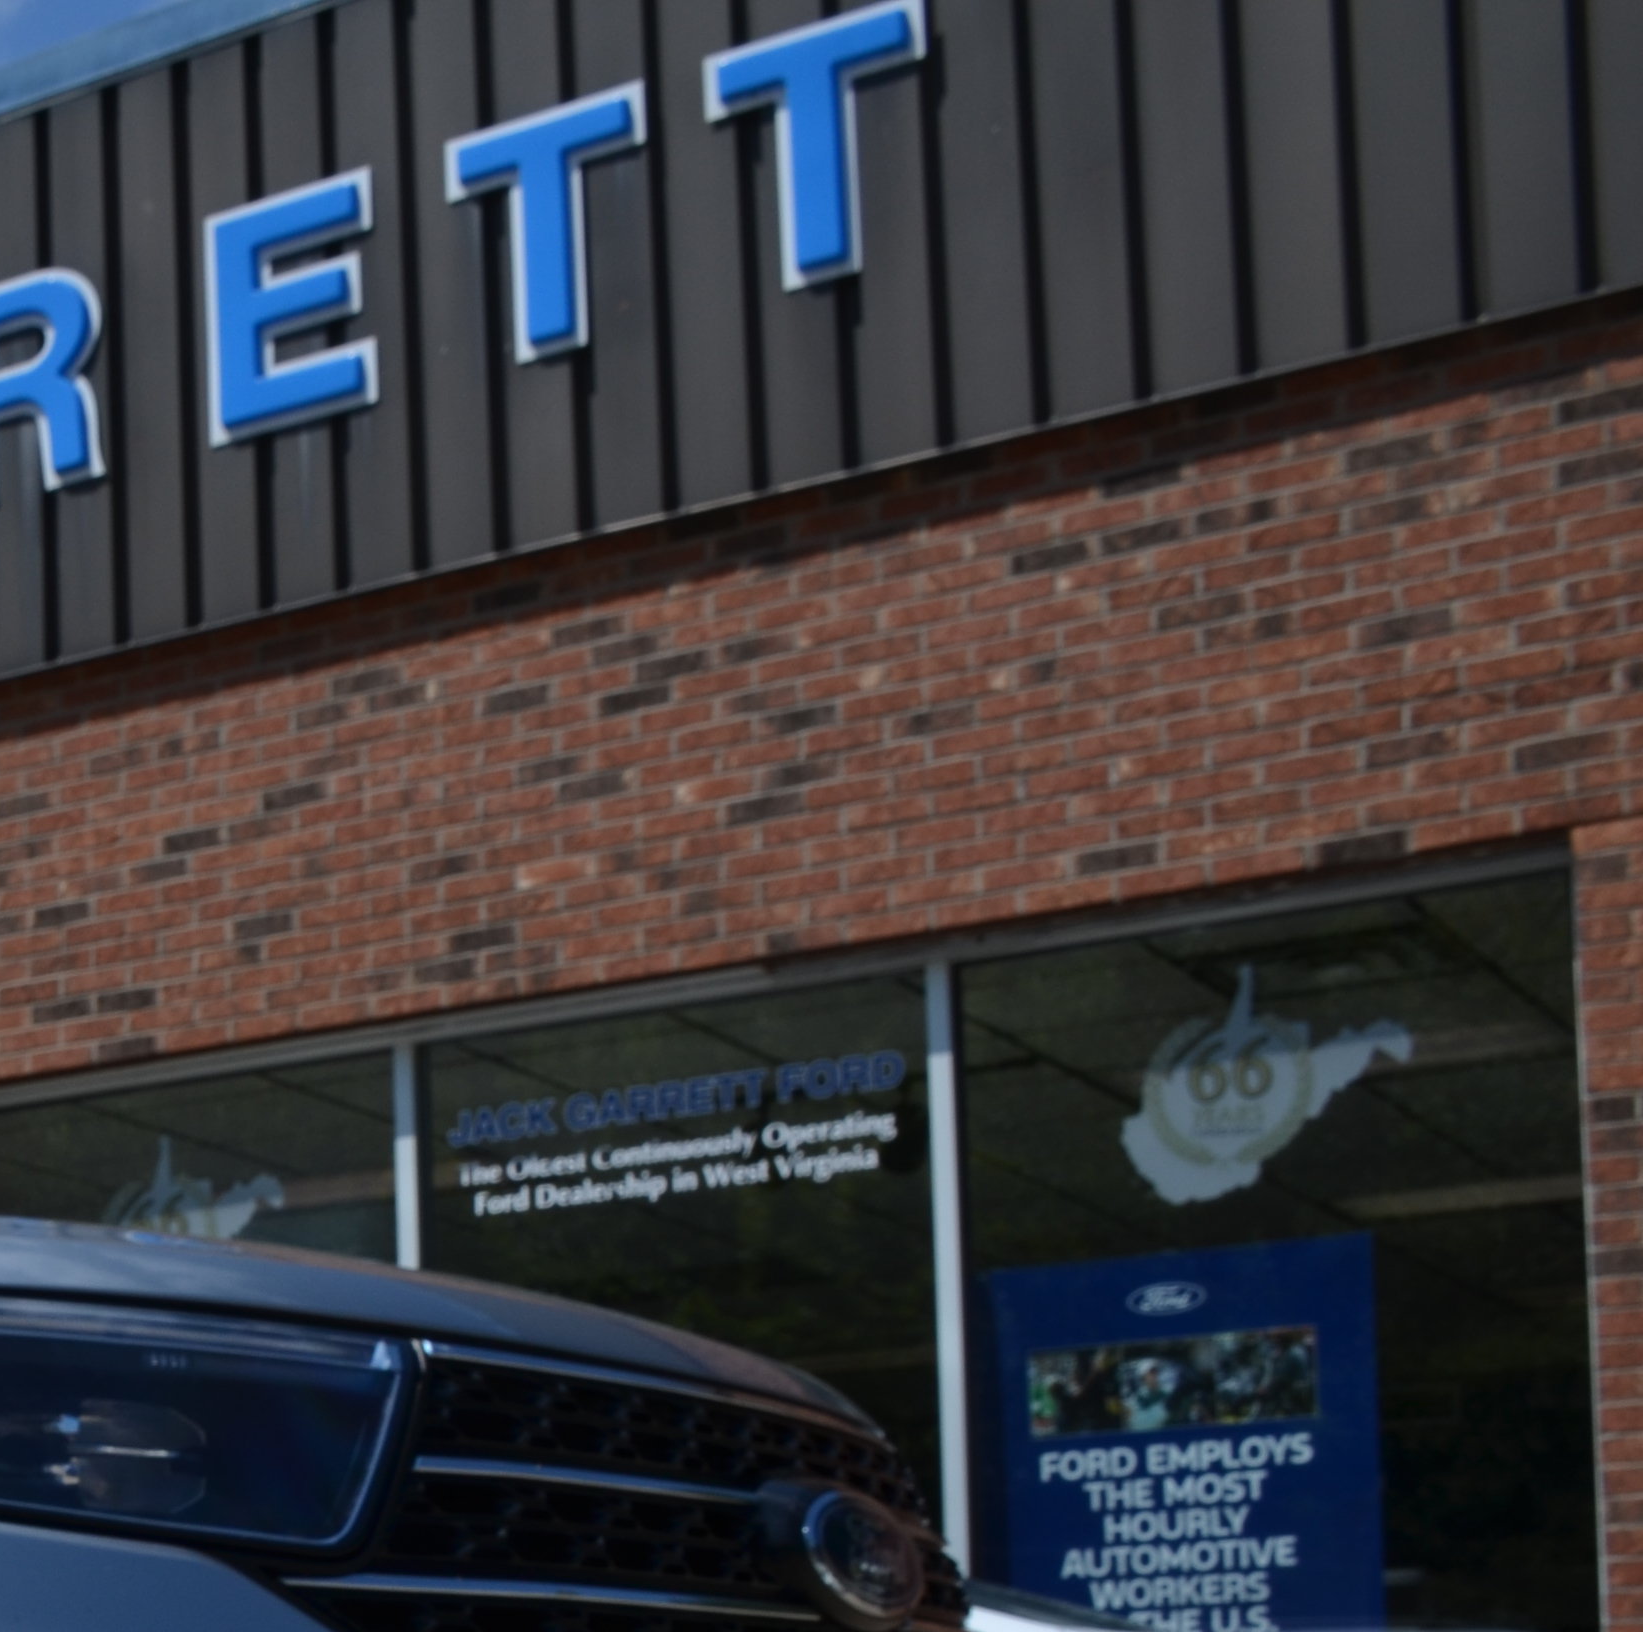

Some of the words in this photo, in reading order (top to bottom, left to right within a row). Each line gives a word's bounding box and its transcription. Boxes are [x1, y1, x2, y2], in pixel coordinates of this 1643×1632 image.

[1188, 1036, 1273, 1104] 66
[447, 1099, 558, 1147] JACK
[563, 1068, 768, 1131] GARRETT
[776, 1049, 906, 1100] FORD
[460, 1161, 503, 1187] The
[591, 1126, 757, 1170] Continuously
[762, 1110, 898, 1152] Operating
[473, 1183, 530, 1217] Ford
[535, 1169, 668, 1204] Dealership
[672, 1165, 699, 1193] in
[702, 1157, 770, 1189] West
[774, 1143, 880, 1184] Virginia
[1039, 1447, 1137, 1482] FORD
[1146, 1433, 1314, 1475] EMPLOYS
[1083, 1478, 1156, 1511] THE
[1163, 1470, 1268, 1507] MOST
[1103, 1505, 1250, 1543] HOURLY
[1061, 1535, 1298, 1579] AUTOMOTIVE
[1089, 1572, 1271, 1611] WORKERS
